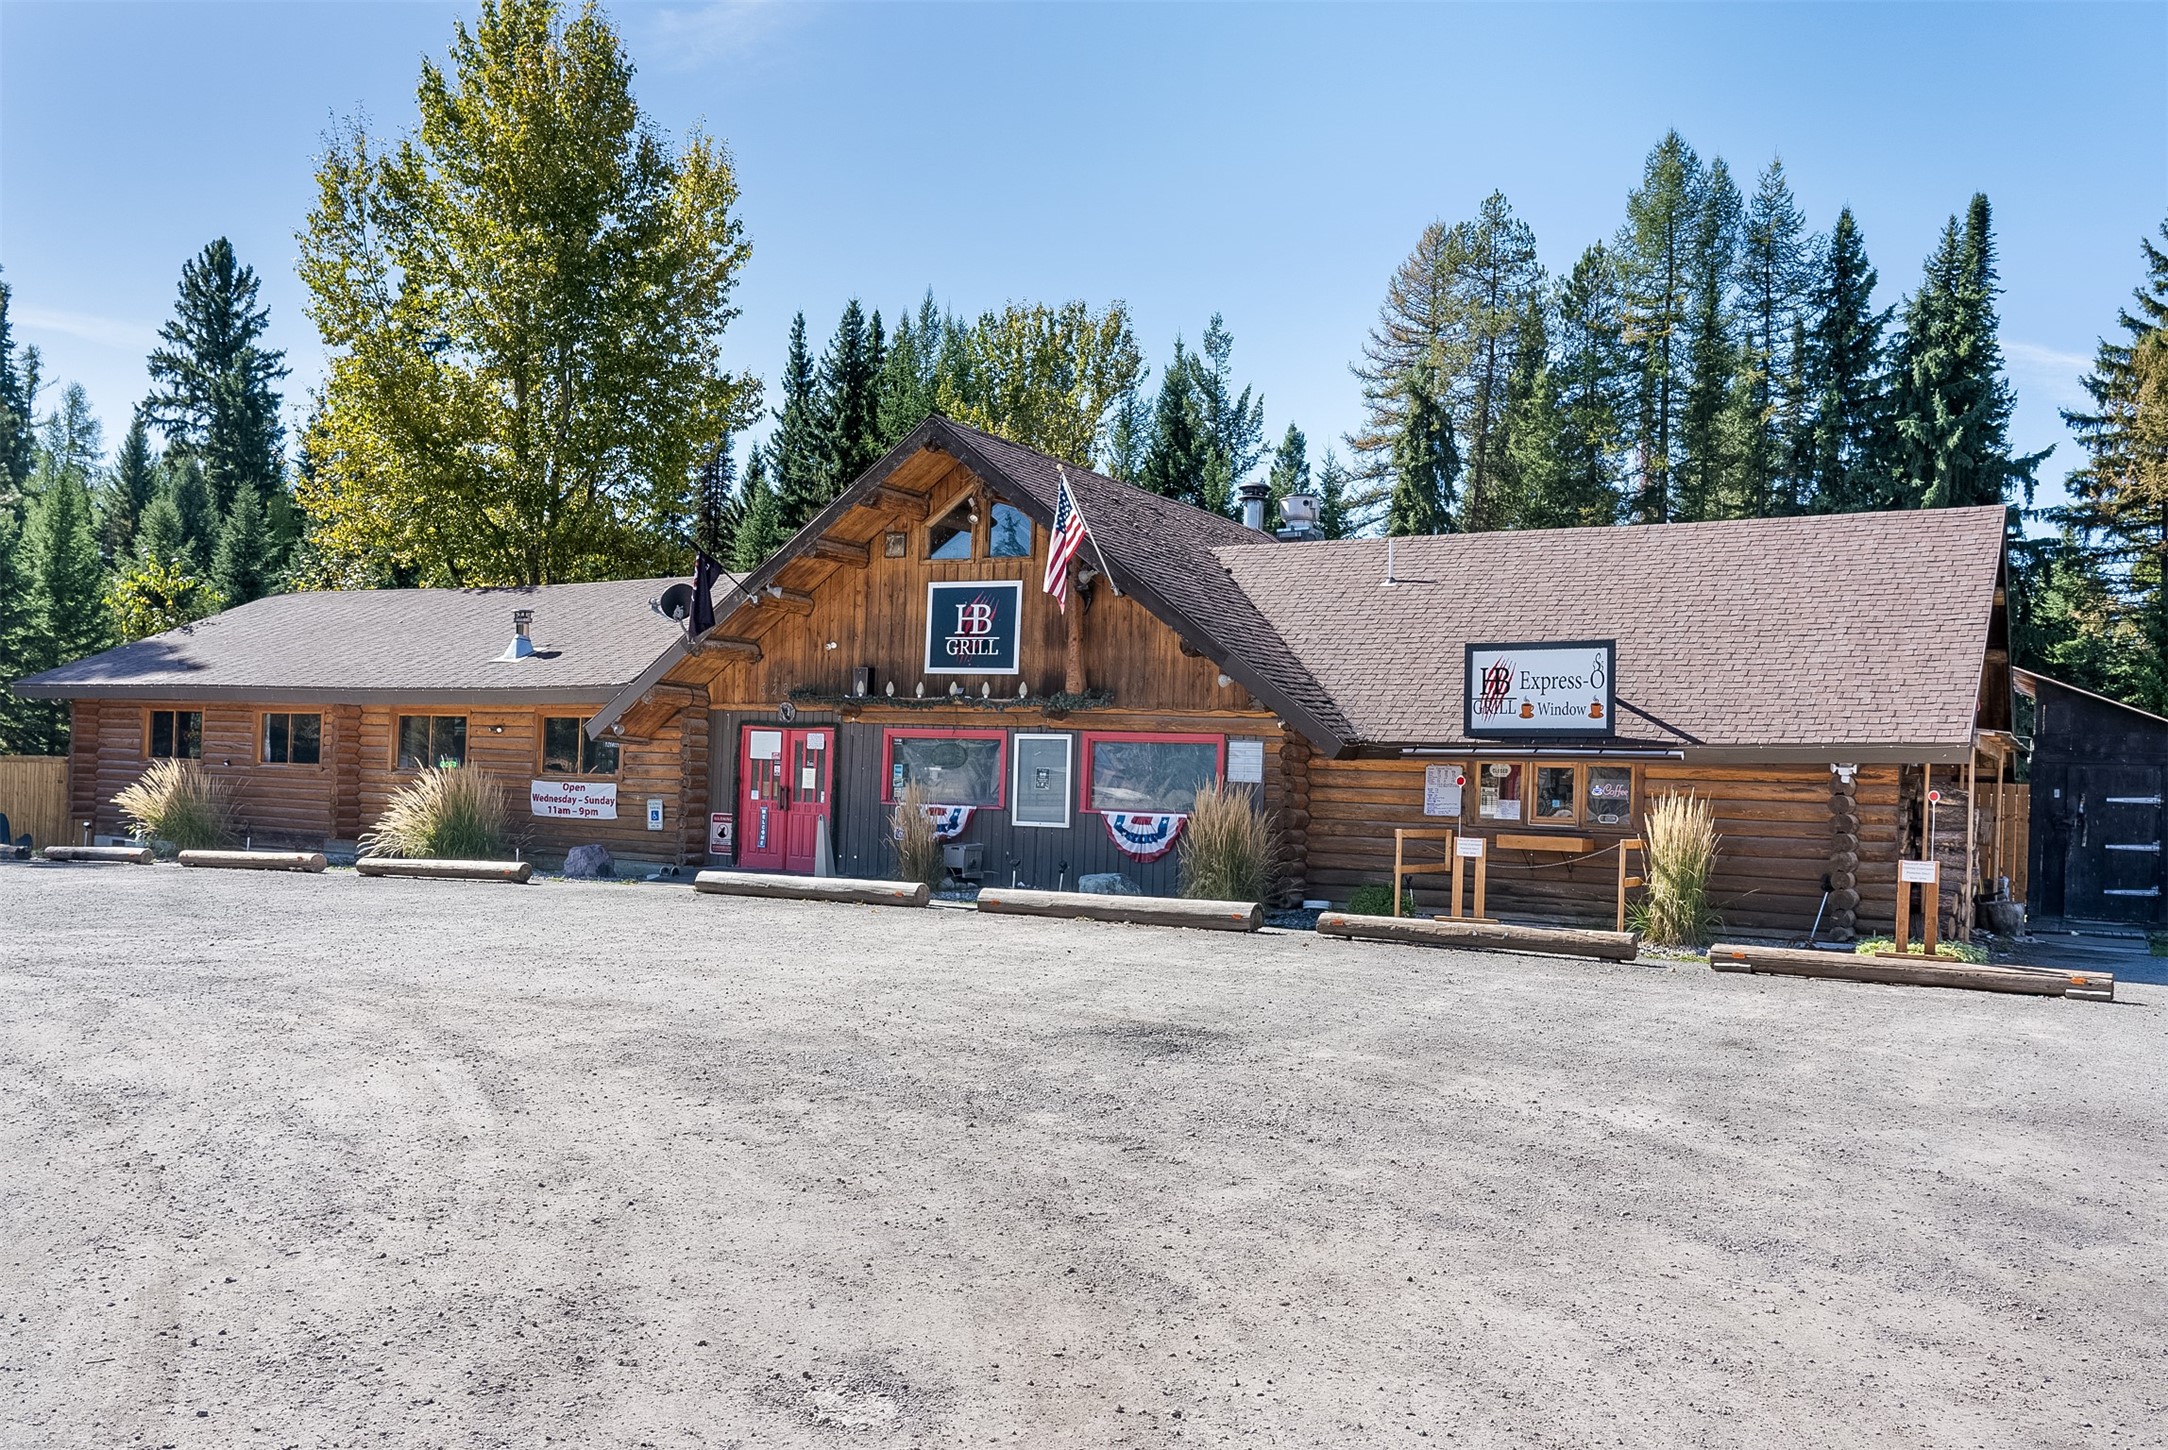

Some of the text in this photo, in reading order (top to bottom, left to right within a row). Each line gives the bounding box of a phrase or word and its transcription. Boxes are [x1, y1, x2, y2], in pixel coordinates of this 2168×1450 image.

[954, 603, 992, 635] HB
[946, 639, 999, 656] GRILL
[760, 682, 801, 696] 628
[1480, 667, 1511, 696] HB
[1519, 669, 1605, 696] Express-O
[1473, 700, 1517, 715] GRILL
[1537, 701, 1587, 716] Window
[562, 782, 586, 793] Open
[1603, 783, 1629, 798] Coffee
[532, 793, 577, 804] Wednesday
[584, 796, 615, 807] Sunday
[547, 805, 571, 815] 11am
[578, 807, 599, 817] 9pm
